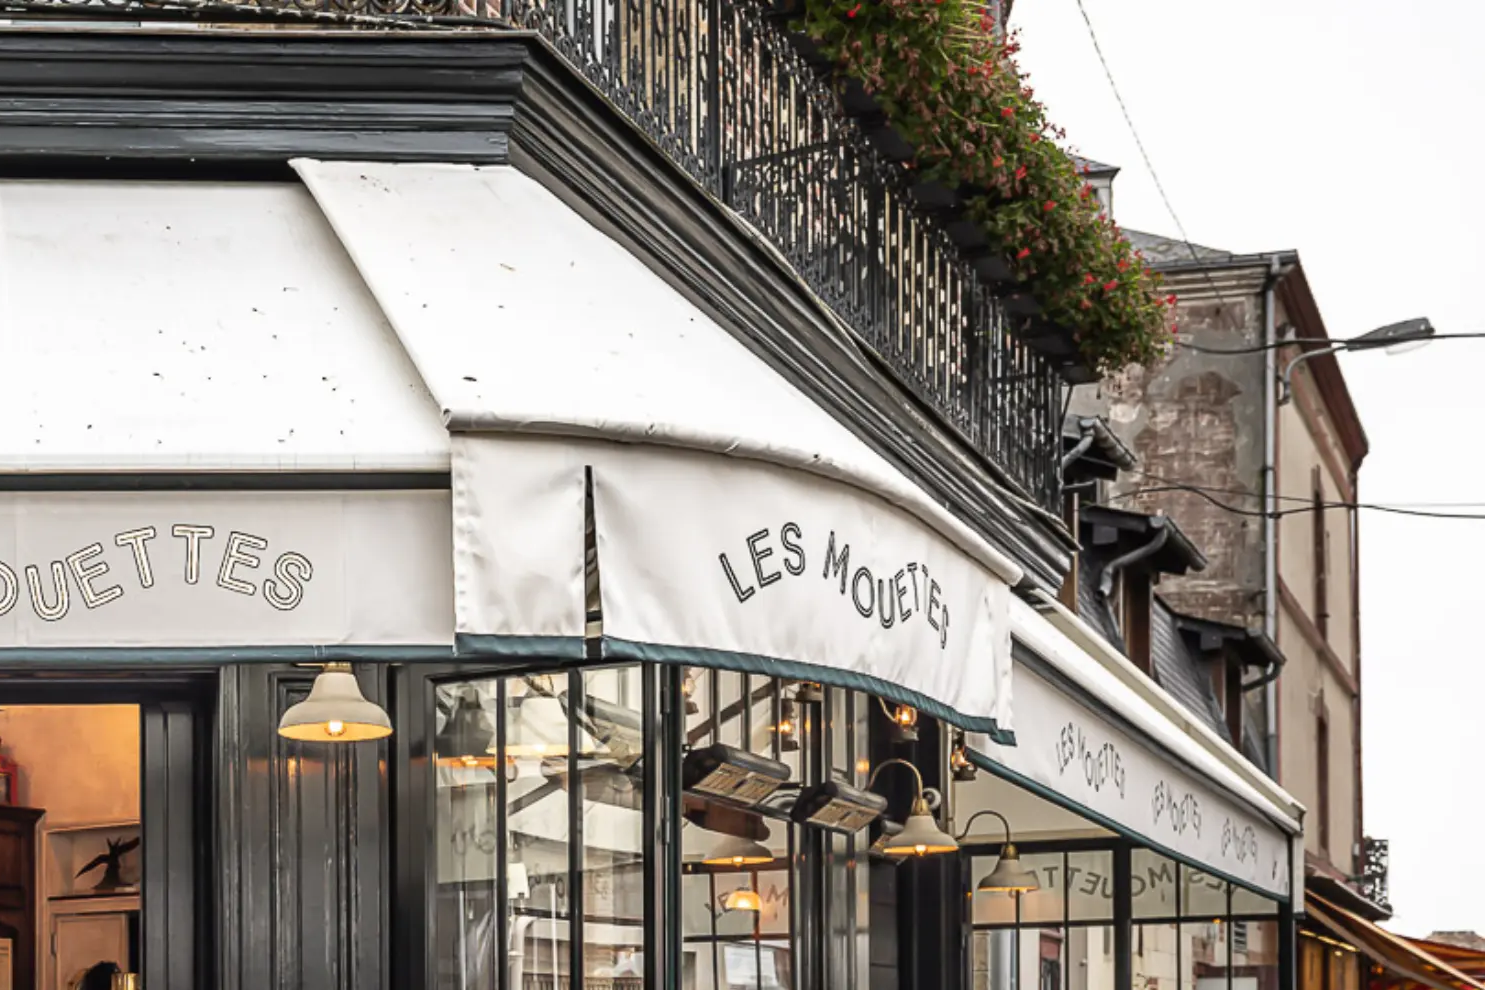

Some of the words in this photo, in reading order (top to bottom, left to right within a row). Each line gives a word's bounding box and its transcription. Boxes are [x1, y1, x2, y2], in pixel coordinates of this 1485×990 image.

[719, 522, 806, 603] LES
[822, 530, 949, 649] MOUETTES
[1056, 722, 1075, 776] LES
